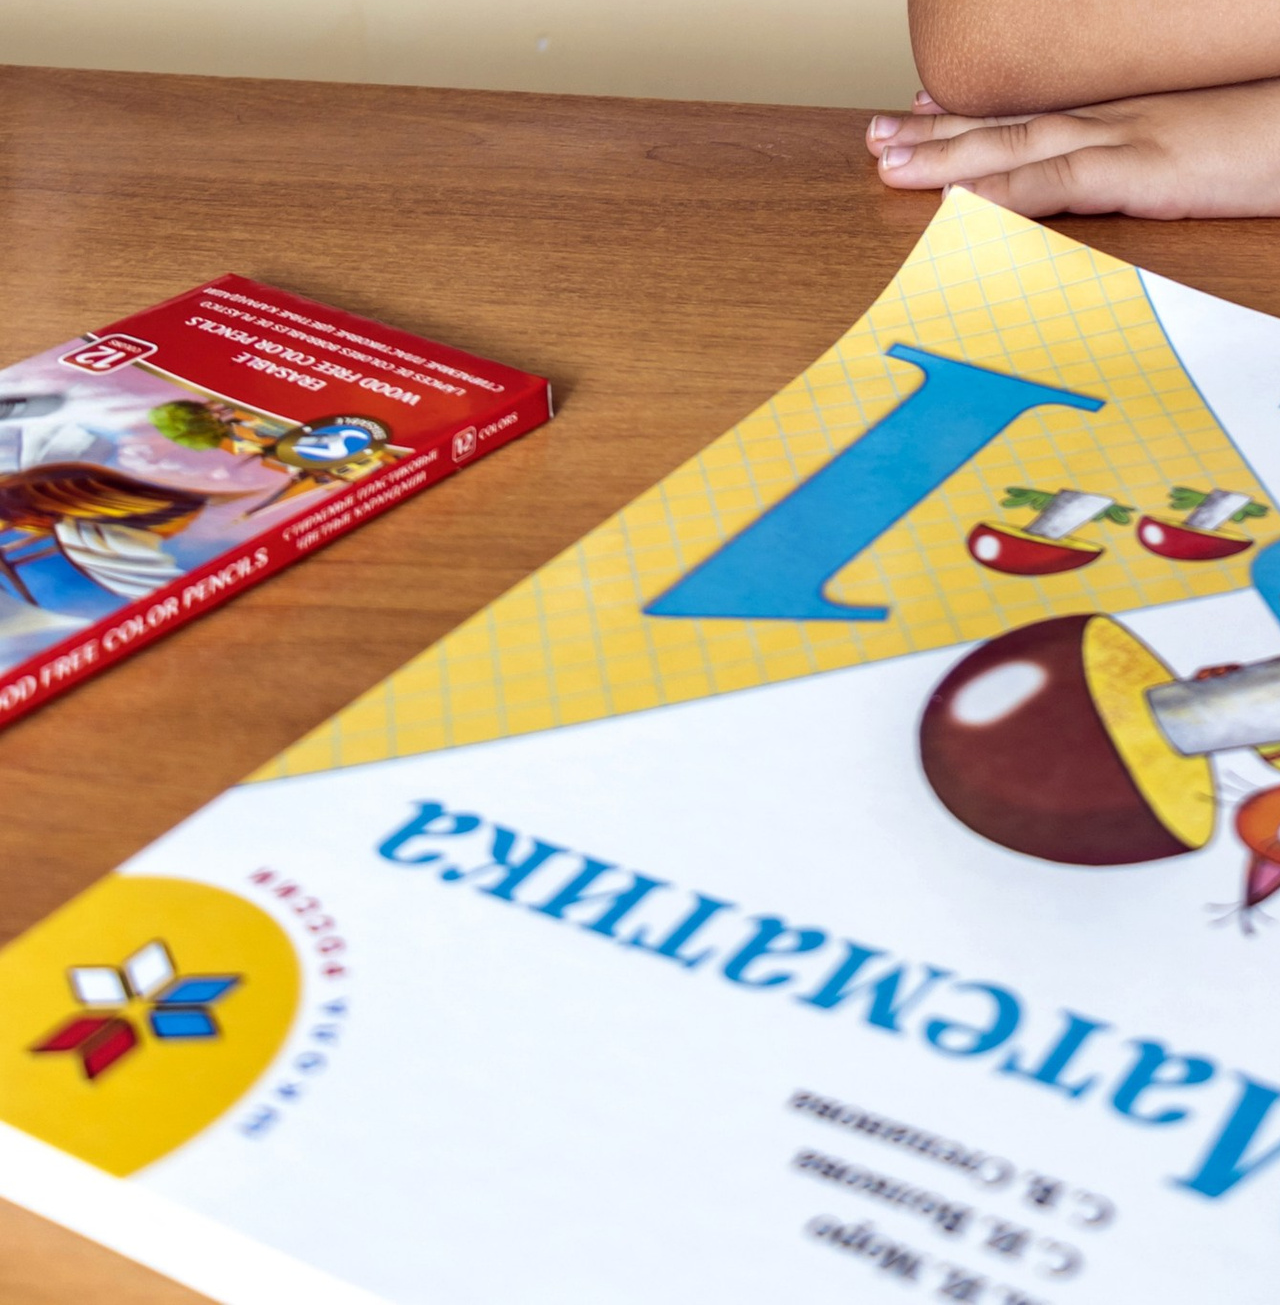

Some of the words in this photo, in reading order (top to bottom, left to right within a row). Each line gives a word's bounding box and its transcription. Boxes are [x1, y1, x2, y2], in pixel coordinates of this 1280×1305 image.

[202, 287, 280, 314] КАРАНДАШИ
[185, 316, 259, 346] PENCILS
[253, 317, 275, 329] DE
[277, 309, 337, 334] ЦВЕТНЫЕ
[253, 338, 317, 366] COLOR
[271, 323, 342, 352] BORRABLES
[333, 329, 427, 365] ПЛАСТИКОВЫЕ
[75, 345, 127, 368] 12
[231, 351, 328, 392] ERASABLE
[311, 359, 363, 384] FREE
[338, 347, 396, 371] COLORES
[393, 365, 416, 379] DE
[424, 360, 505, 393] СТИРАЕМЫЕ
[359, 377, 422, 407] WOOD
[453, 432, 474, 457] 12
[478, 411, 519, 441] COLORS
[282, 495, 354, 542] СТИРАЕМЫЕ
[356, 448, 439, 501] ПЛАСТИКОВЫЕ
[354, 471, 427, 518] КАРАНДАШИ
[643, 342, 1106, 624] 1
[0, 675, 37, 711] OD
[40, 638, 99, 688] FREE
[102, 596, 180, 652] COLOR
[182, 546, 270, 609] PENCILS
[804, 1213, 924, 1283] Моро
